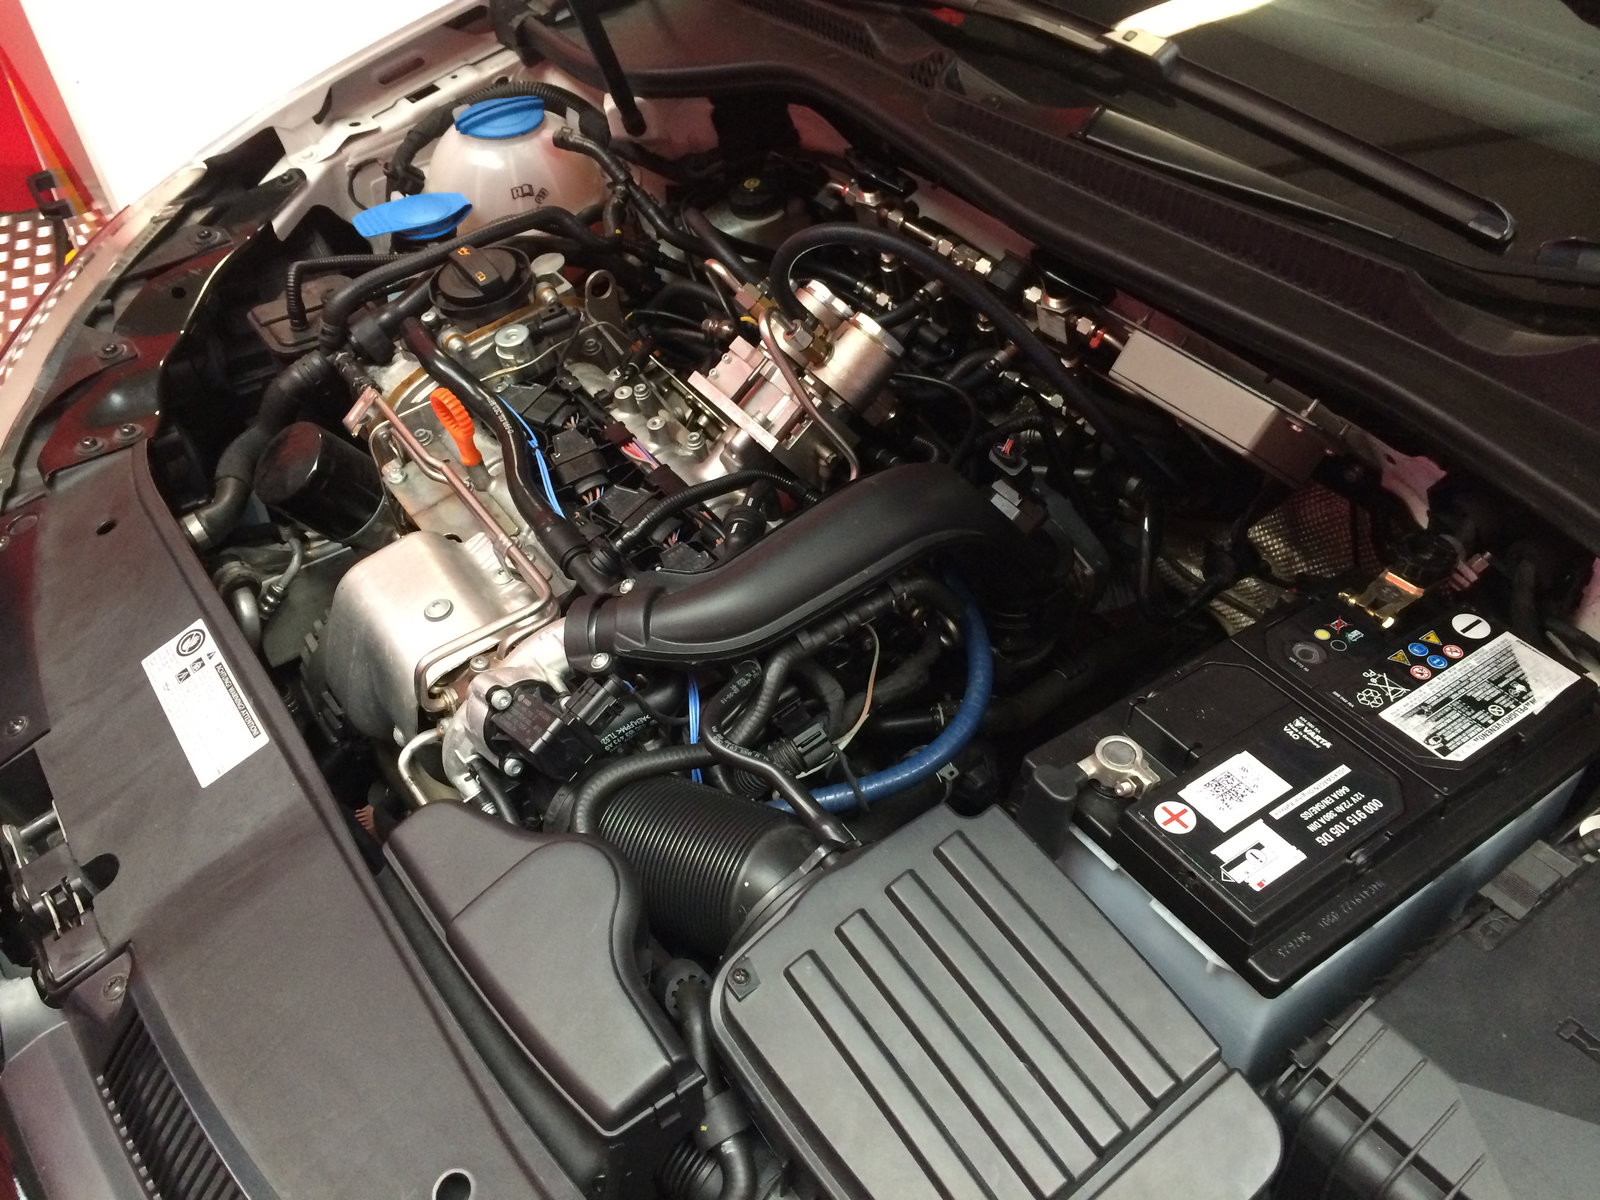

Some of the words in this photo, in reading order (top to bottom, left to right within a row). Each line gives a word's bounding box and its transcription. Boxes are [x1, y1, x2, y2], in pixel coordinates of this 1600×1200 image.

[1283, 725, 1300, 740] VAO
[1303, 726, 1332, 749] VARTA
[1331, 785, 1350, 800] 640A
[1350, 791, 1365, 804] 12V
[1333, 799, 1354, 813] 72Ah
[1362, 798, 1384, 814] 000
[1317, 810, 1339, 824] 380A
[1346, 809, 1367, 826] 915
[1306, 820, 1323, 833] DIN
[1329, 821, 1350, 838] 105
[1315, 831, 1335, 847] DG
